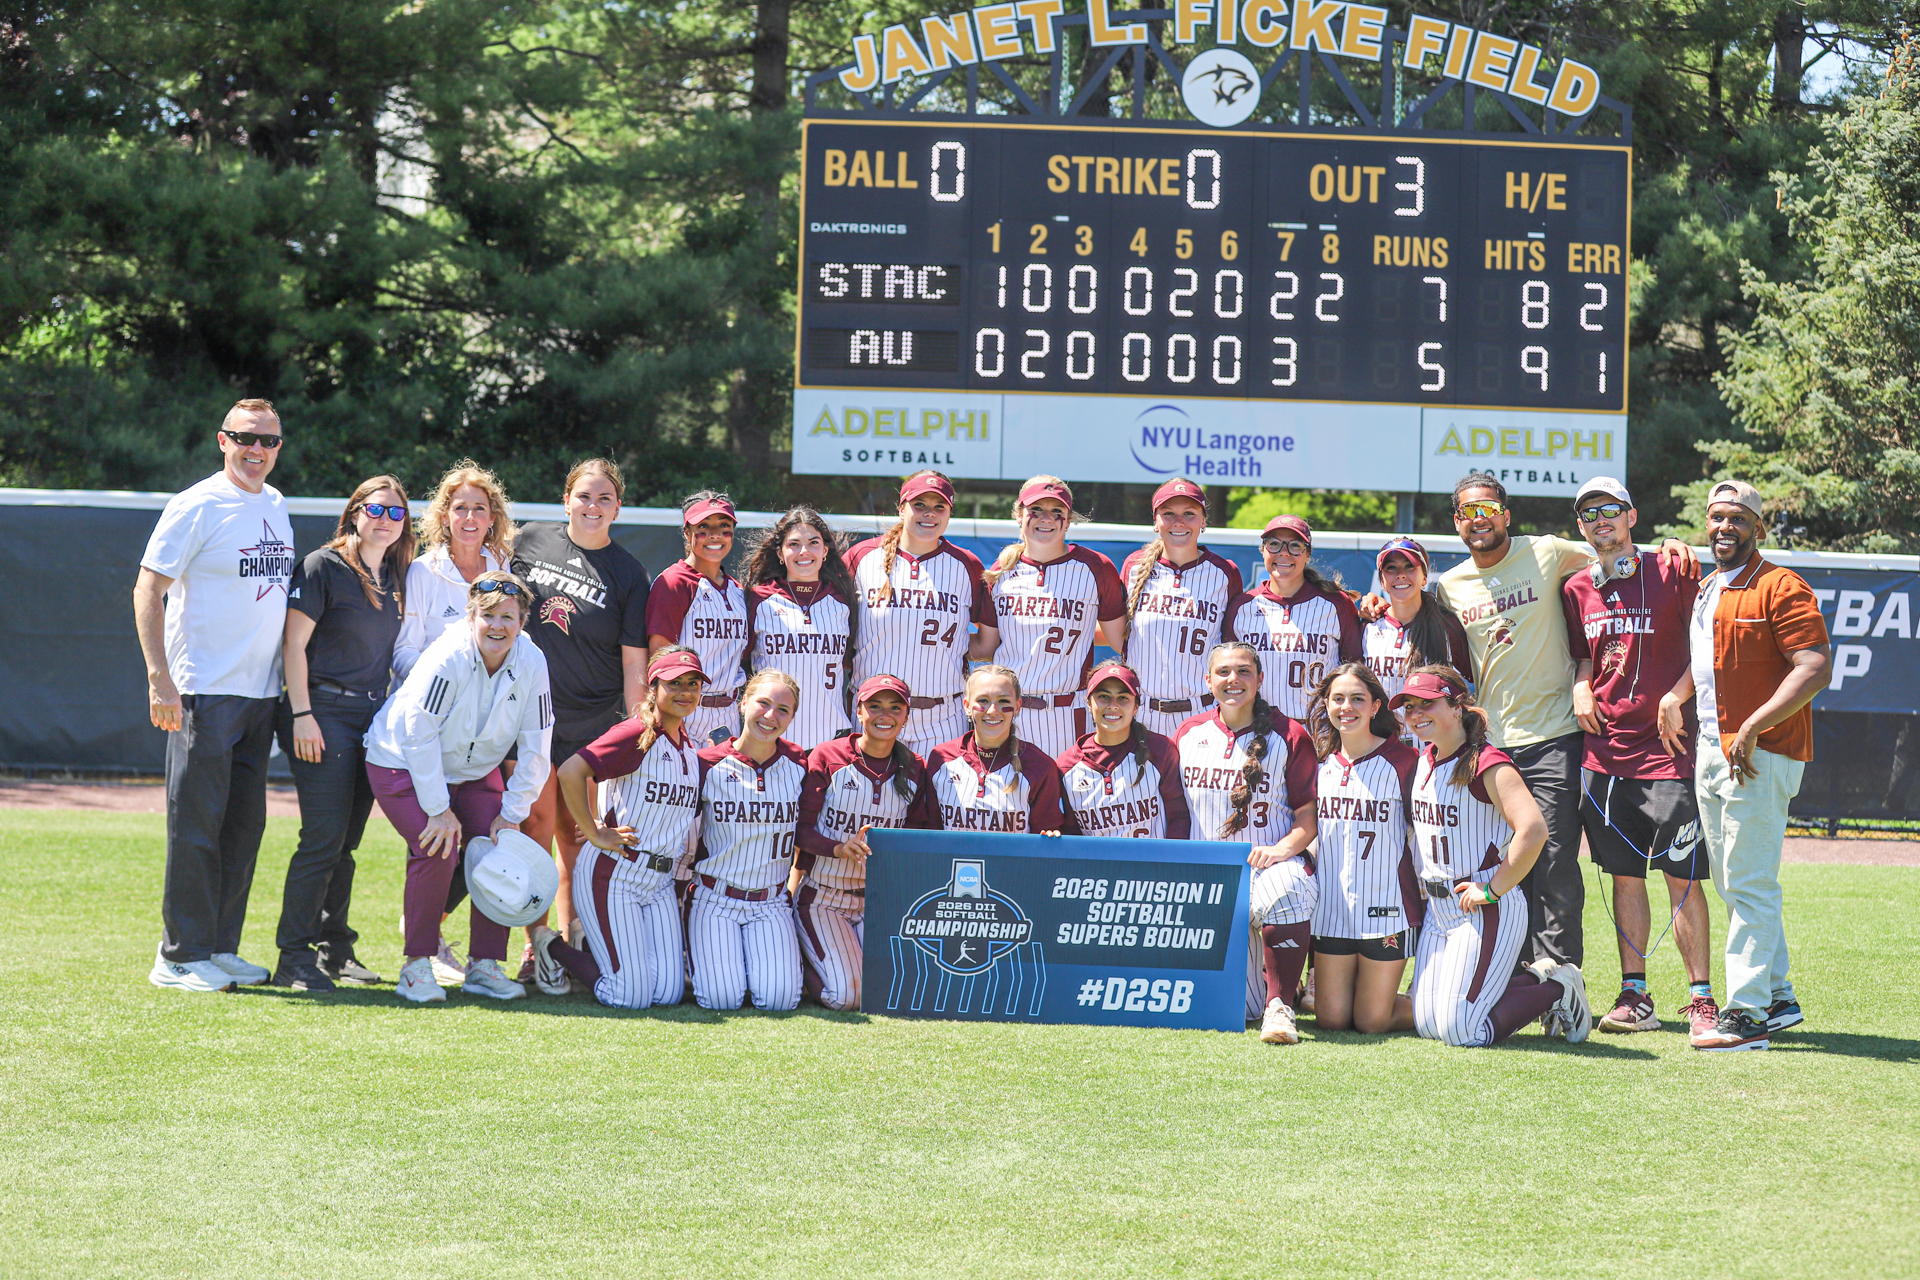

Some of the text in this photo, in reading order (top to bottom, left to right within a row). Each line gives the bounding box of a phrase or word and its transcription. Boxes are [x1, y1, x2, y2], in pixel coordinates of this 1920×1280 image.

[837, 0, 1600, 117] JANET L. FICKE FIELD
[824, 141, 966, 202] BALL 0
[1047, 148, 1222, 209] STRIKE 0
[1309, 155, 1425, 217] OUT 3
[1505, 171, 1567, 214] H/E
[810, 222, 908, 235] DAKTRONICS
[987, 223, 1621, 275] 1 2 3 4 5 6 7 8 RUNS HITS ERR
[819, 262, 1608, 332] STAC 1 0 0 0 2 0 2 2 7 8 2
[849, 327, 1608, 395] AU 0 2 0 0 0 0 3 5 9 1
[808, 404, 990, 441] ADELPHI
[1142, 426, 1294, 457] NYU Langone
[1434, 422, 1615, 462] ADELPHI
[842, 449, 955, 465] SOFTBALL
[1185, 454, 1262, 478] Health
[264, 544, 285, 556] ECC
[542, 562, 563, 573] THOMAS
[527, 567, 607, 609] SOFTBALL
[796, 585, 813, 593] STAC
[1510, 579, 1532, 591] COLLEGE
[998, 595, 1085, 621] SPARTANS
[1138, 592, 1218, 623] PARTANS
[1462, 587, 1539, 625] SOFTBALL
[921, 619, 958, 648] 24
[1044, 626, 1082, 656] 27
[1178, 626, 1208, 655] 16
[1584, 616, 1655, 640] SOFTBALL
[765, 633, 847, 655] SPARTANS
[1243, 632, 1328, 655] SPARTANS
[825, 662, 836, 690] 5
[1184, 766, 1270, 794] SPARTAS
[772, 831, 795, 859] 10
[1358, 831, 1376, 860] 7
[1431, 835, 1450, 865] 11
[1052, 877, 1224, 905] 2026 DIVISION II
[935, 910, 998, 920] SOFTBALL
[937, 901, 997, 911] 2026 DII
[1086, 901, 1185, 926] SOFTBALL
[904, 919, 1028, 939] CHAMPIONSHIP
[1056, 922, 1215, 950] SUPERS BOUND
[1076, 977, 1195, 1014] #D2SB
